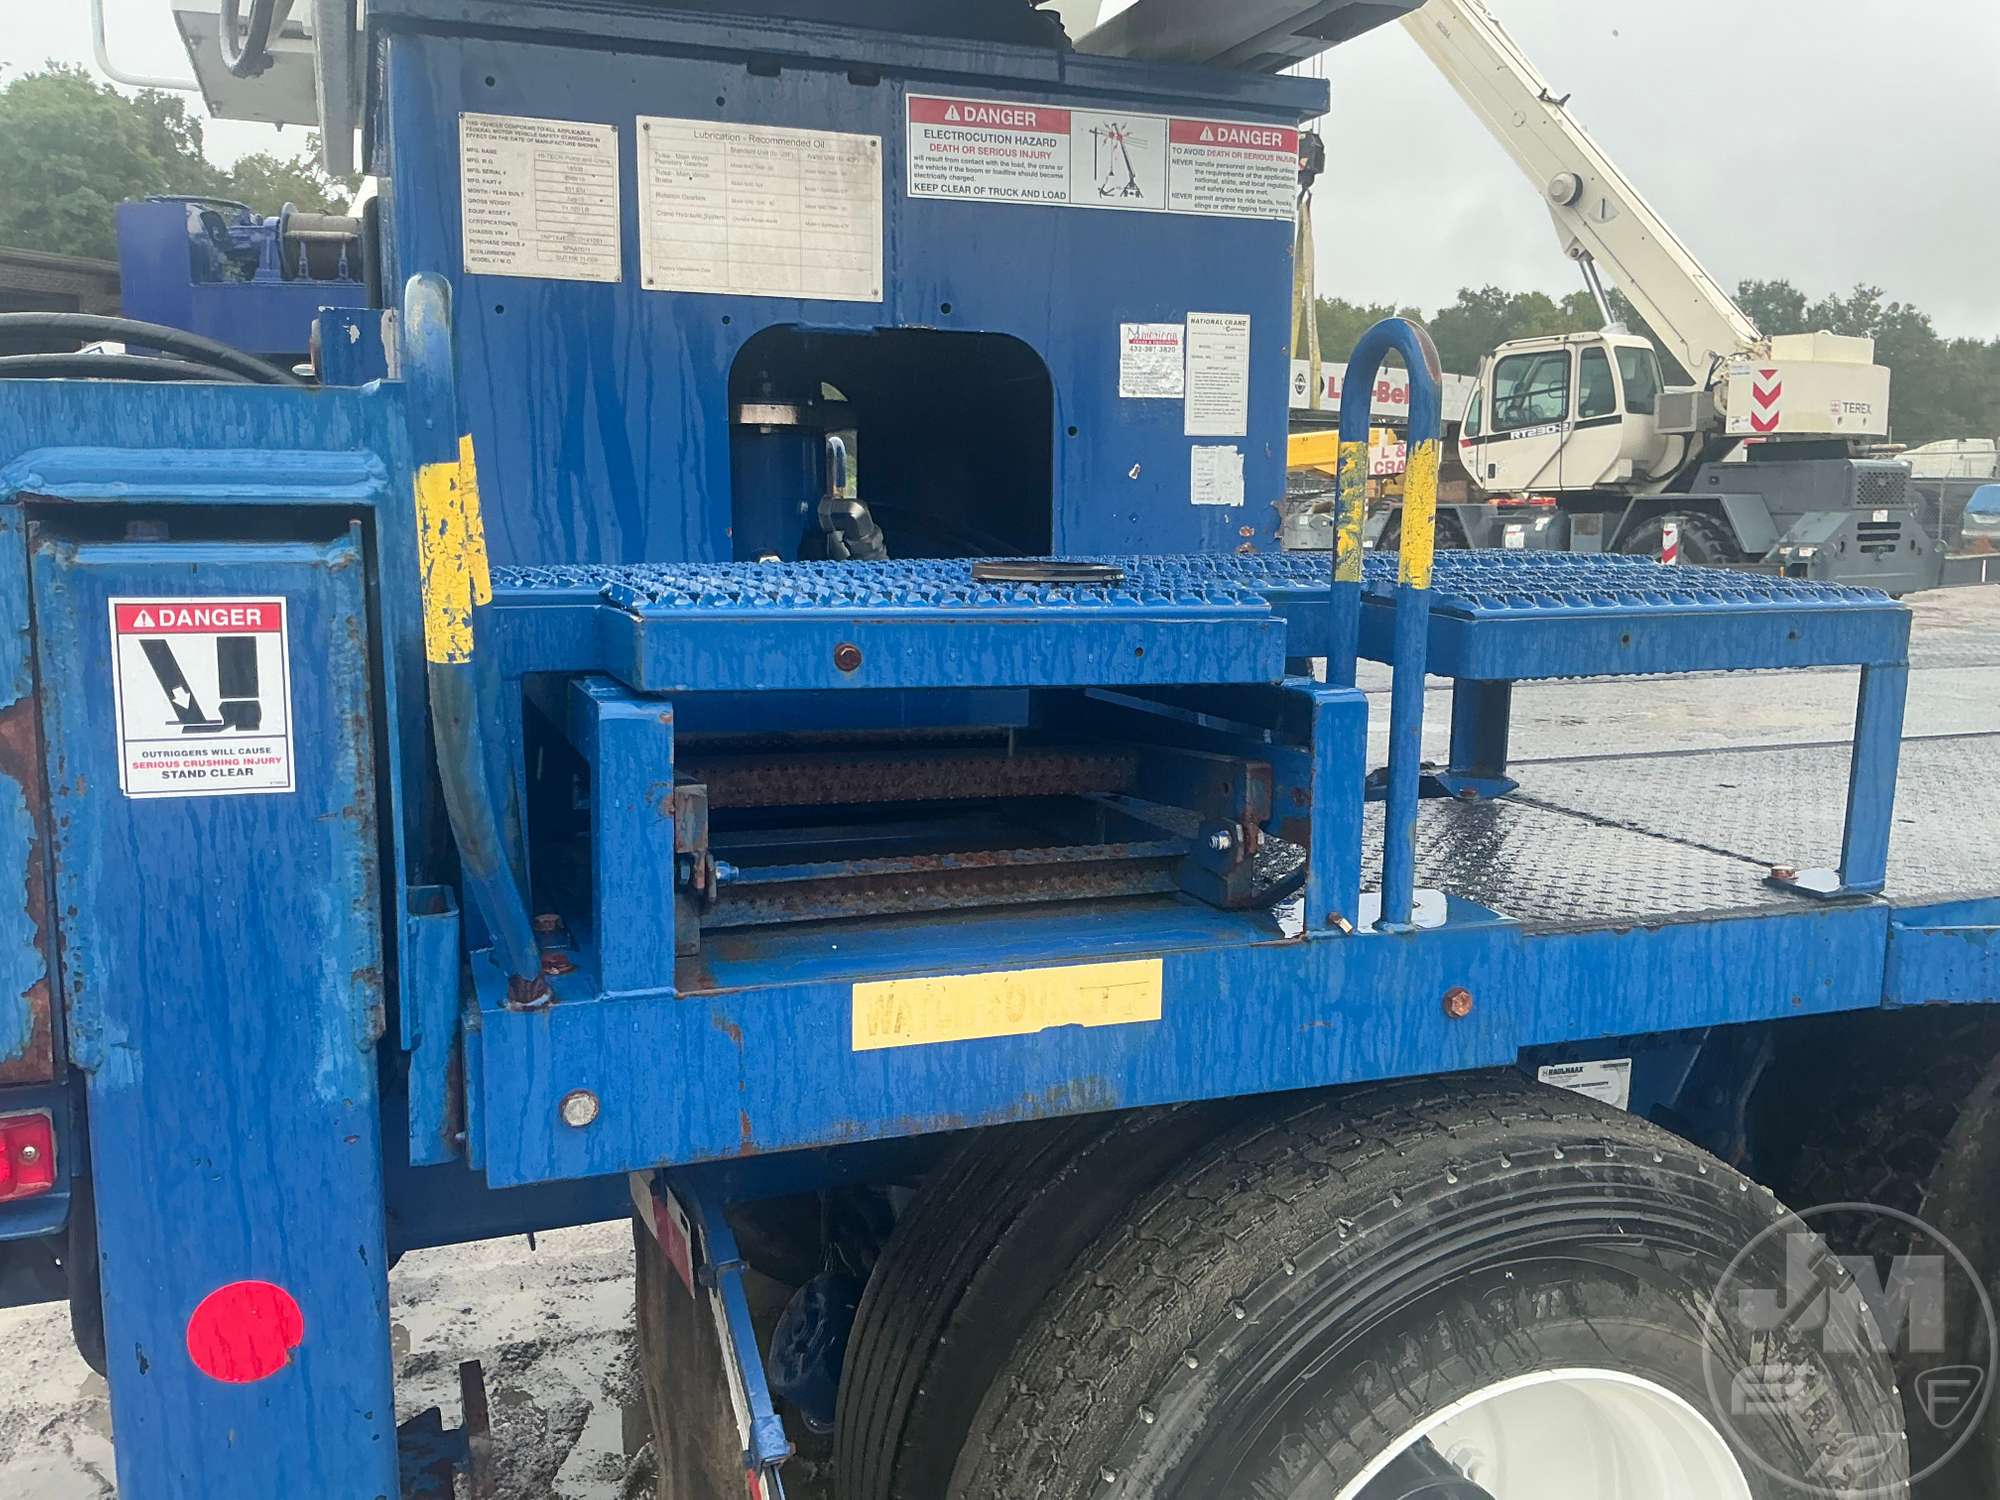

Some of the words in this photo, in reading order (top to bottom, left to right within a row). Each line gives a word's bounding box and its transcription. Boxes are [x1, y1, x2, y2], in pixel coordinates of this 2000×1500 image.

[964, 106, 1037, 127] DANGER
[694, 127, 741, 142] Lubrication
[749, 133, 811, 148] Recommended
[813, 140, 825, 149] Oil
[924, 129, 1012, 145] ELECTROCUTION
[1015, 136, 1057, 148] HAZARD
[1217, 127, 1282, 147] DANGER
[930, 143, 960, 153] DEATH
[962, 145, 976, 154] OR
[977, 146, 1018, 158] SERIOUS
[1019, 149, 1053, 160] INJURY
[1172, 147, 1183, 155] TO
[1183, 147, 1206, 156] AVOID
[1207, 149, 1230, 158] DEATH
[1231, 151, 1243, 159] OR
[1243, 152, 1275, 162] SERIOUS
[960, 158, 984, 166] contact
[999, 159, 1010, 167] the
[1027, 161, 1037, 169] the
[1216, 162, 1246, 170] personnel
[913, 172, 947, 181] electrically
[925, 164, 947, 172] vehicle
[1039, 171, 1064, 179] become
[1206, 170, 1244, 179] requirements
[914, 183, 939, 192] KEEP
[940, 184, 971, 194] CLEAR
[973, 187, 986, 195] OF
[988, 187, 1020, 197] TRUCK
[1021, 189, 1040, 198] AND
[1042, 190, 1067, 200] LOAD
[1207, 186, 1225, 194] safety
[1215, 196, 1236, 205] anyone
[1238, 205, 1257, 213] rigging
[1190, 318, 1223, 326] NATIONAL
[1843, 401, 1873, 415] TEREX
[1381, 447, 1390, 459] L
[1374, 461, 1406, 475] CRA
[158, 608, 262, 627] DANGER
[142, 749, 208, 758] OUTRIGGERS
[211, 748, 235, 756] WILL
[238, 747, 272, 755] CAUSE
[132, 760, 180, 770] SERIOUS
[183, 758, 240, 768] CRUSHING
[243, 756, 282, 766] INJURY
[162, 769, 207, 780] STAND
[210, 767, 254, 778] CLEAR
